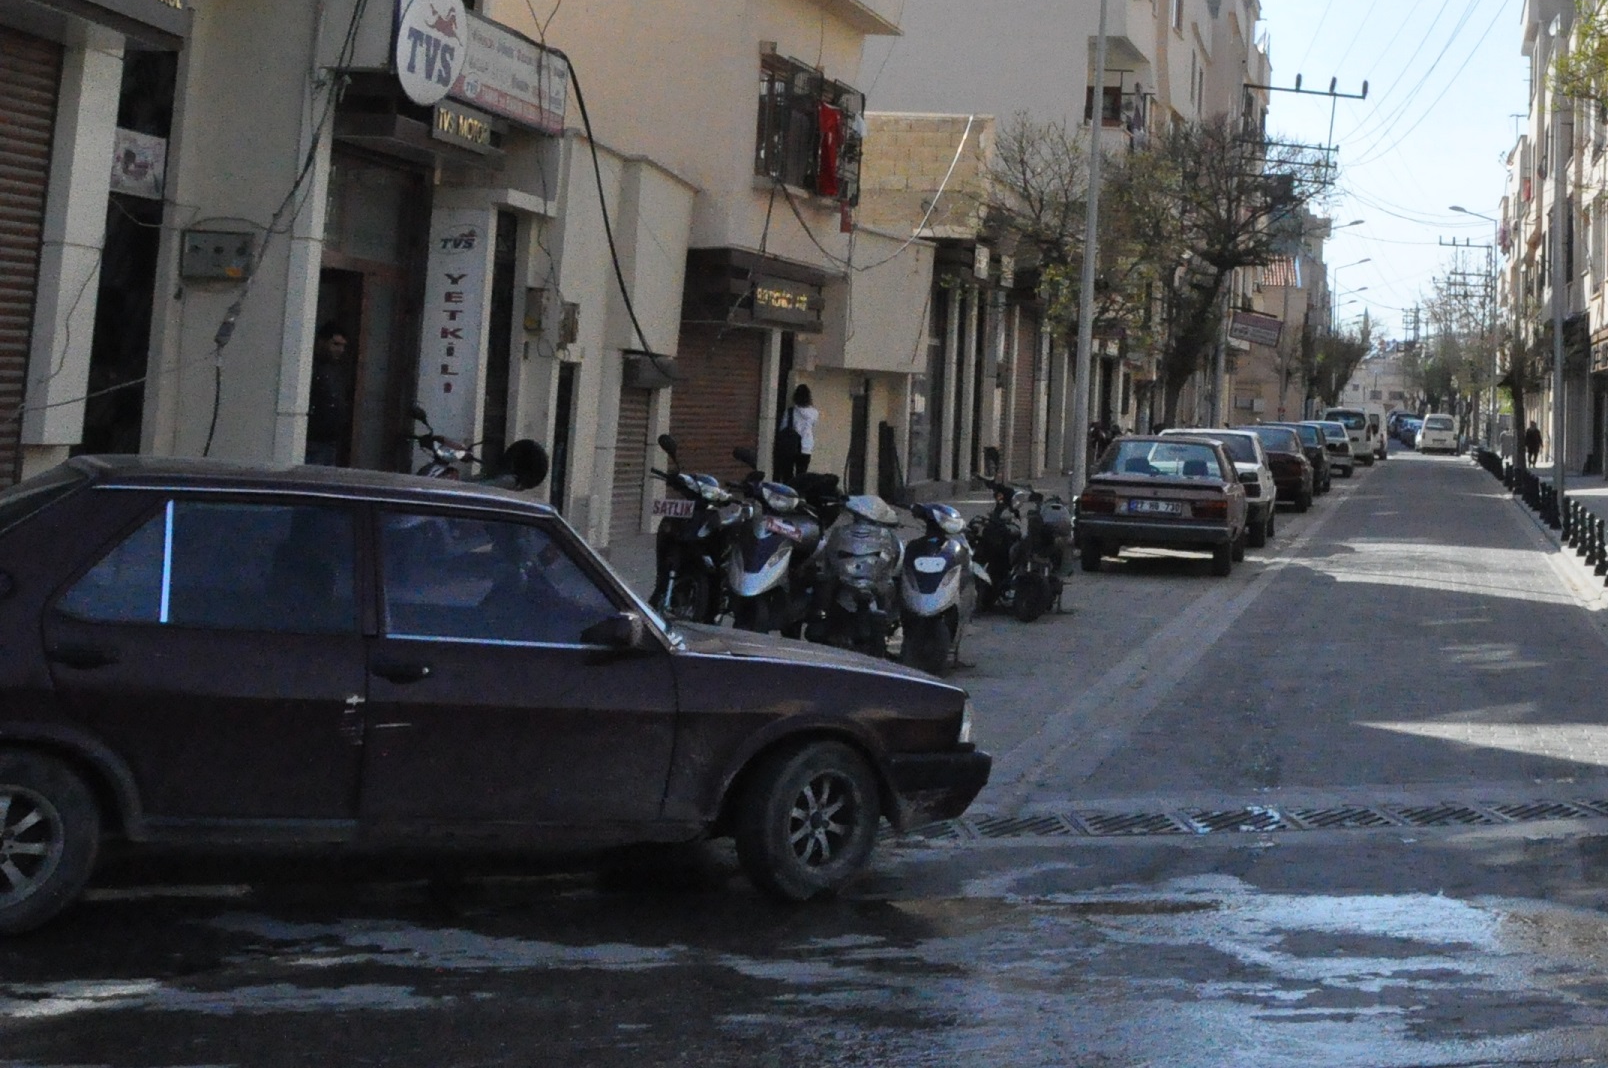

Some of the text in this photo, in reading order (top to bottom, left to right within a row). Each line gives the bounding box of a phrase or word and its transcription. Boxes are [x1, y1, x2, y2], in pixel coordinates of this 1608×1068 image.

[407, 26, 455, 88] TVS
[440, 238, 475, 250] TVS
[652, 500, 694, 516] SATLIK
